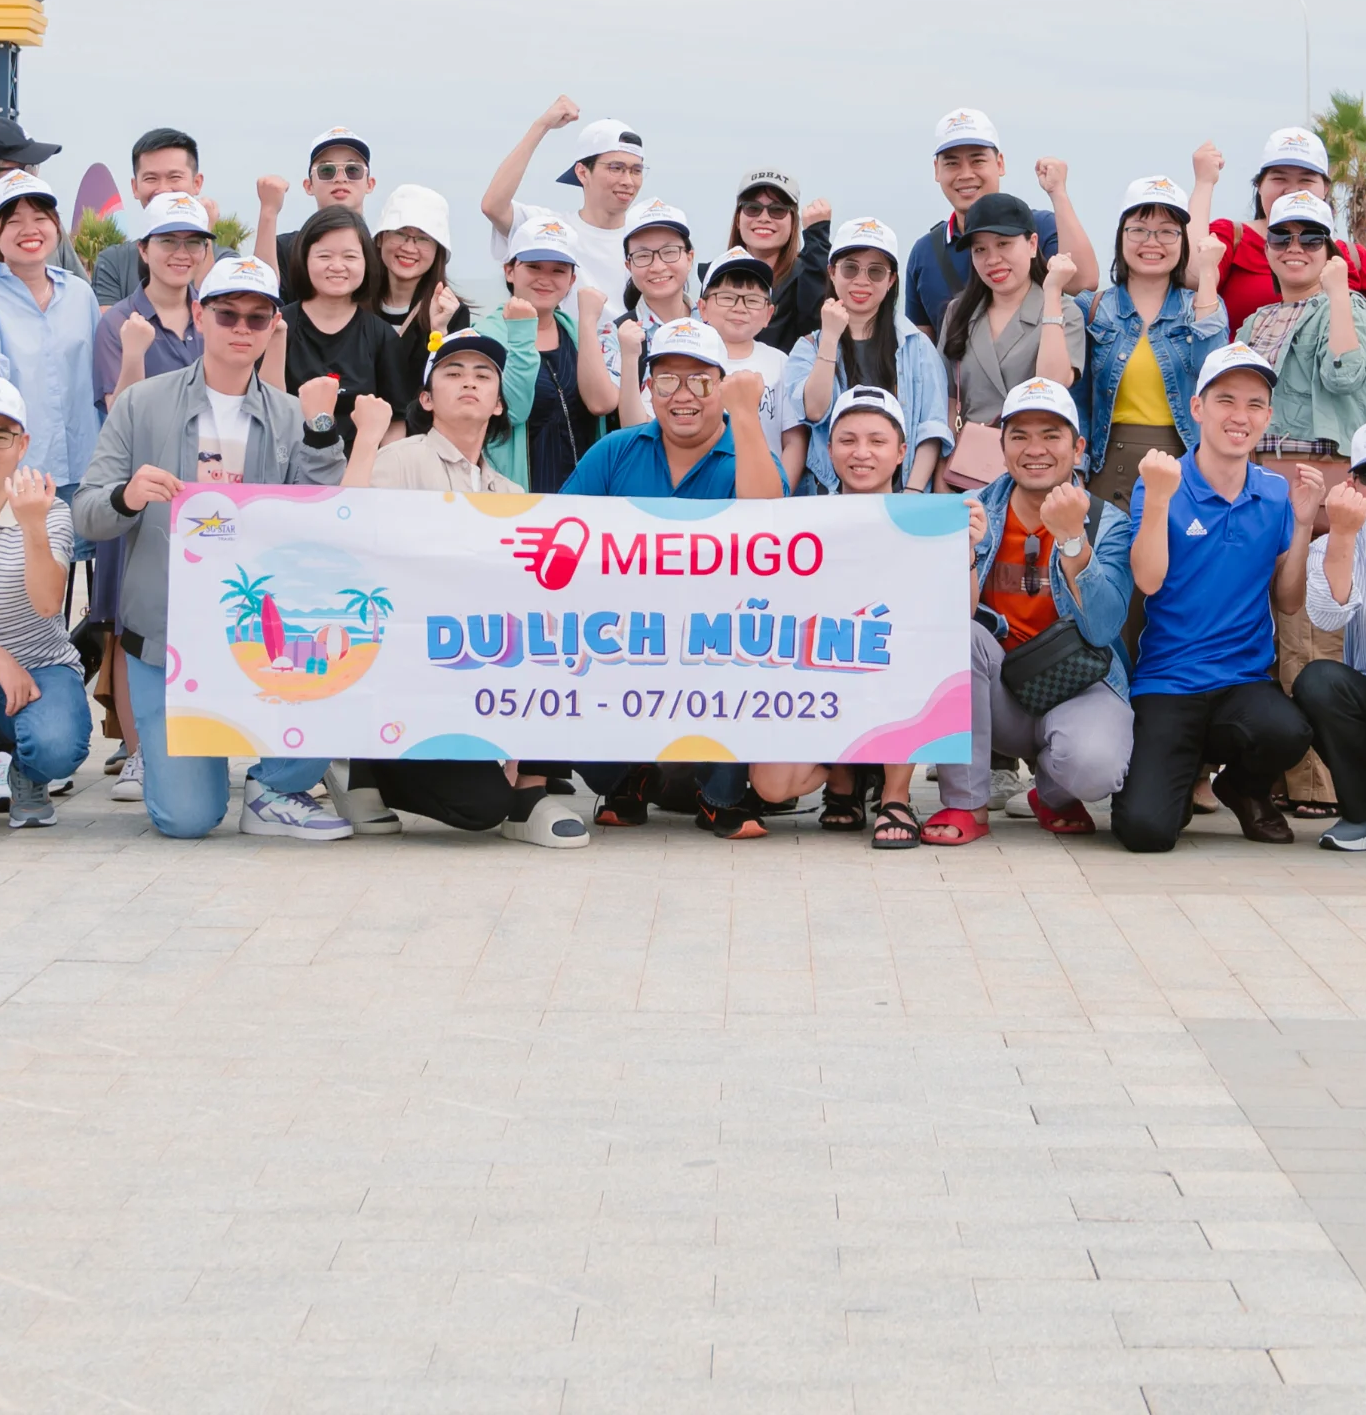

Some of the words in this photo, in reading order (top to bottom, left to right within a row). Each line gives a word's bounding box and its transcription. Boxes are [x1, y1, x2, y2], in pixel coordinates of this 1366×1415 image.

[750, 171, 790, 184] GREAT
[601, 531, 824, 578] MEDIGO
[426, 612, 505, 663] DU
[526, 610, 667, 670] LỊCH
[686, 596, 797, 660] MŨI
[815, 602, 893, 666] NÉ
[474, 688, 583, 721] 05/01
[621, 688, 841, 721] 07/01/2023
